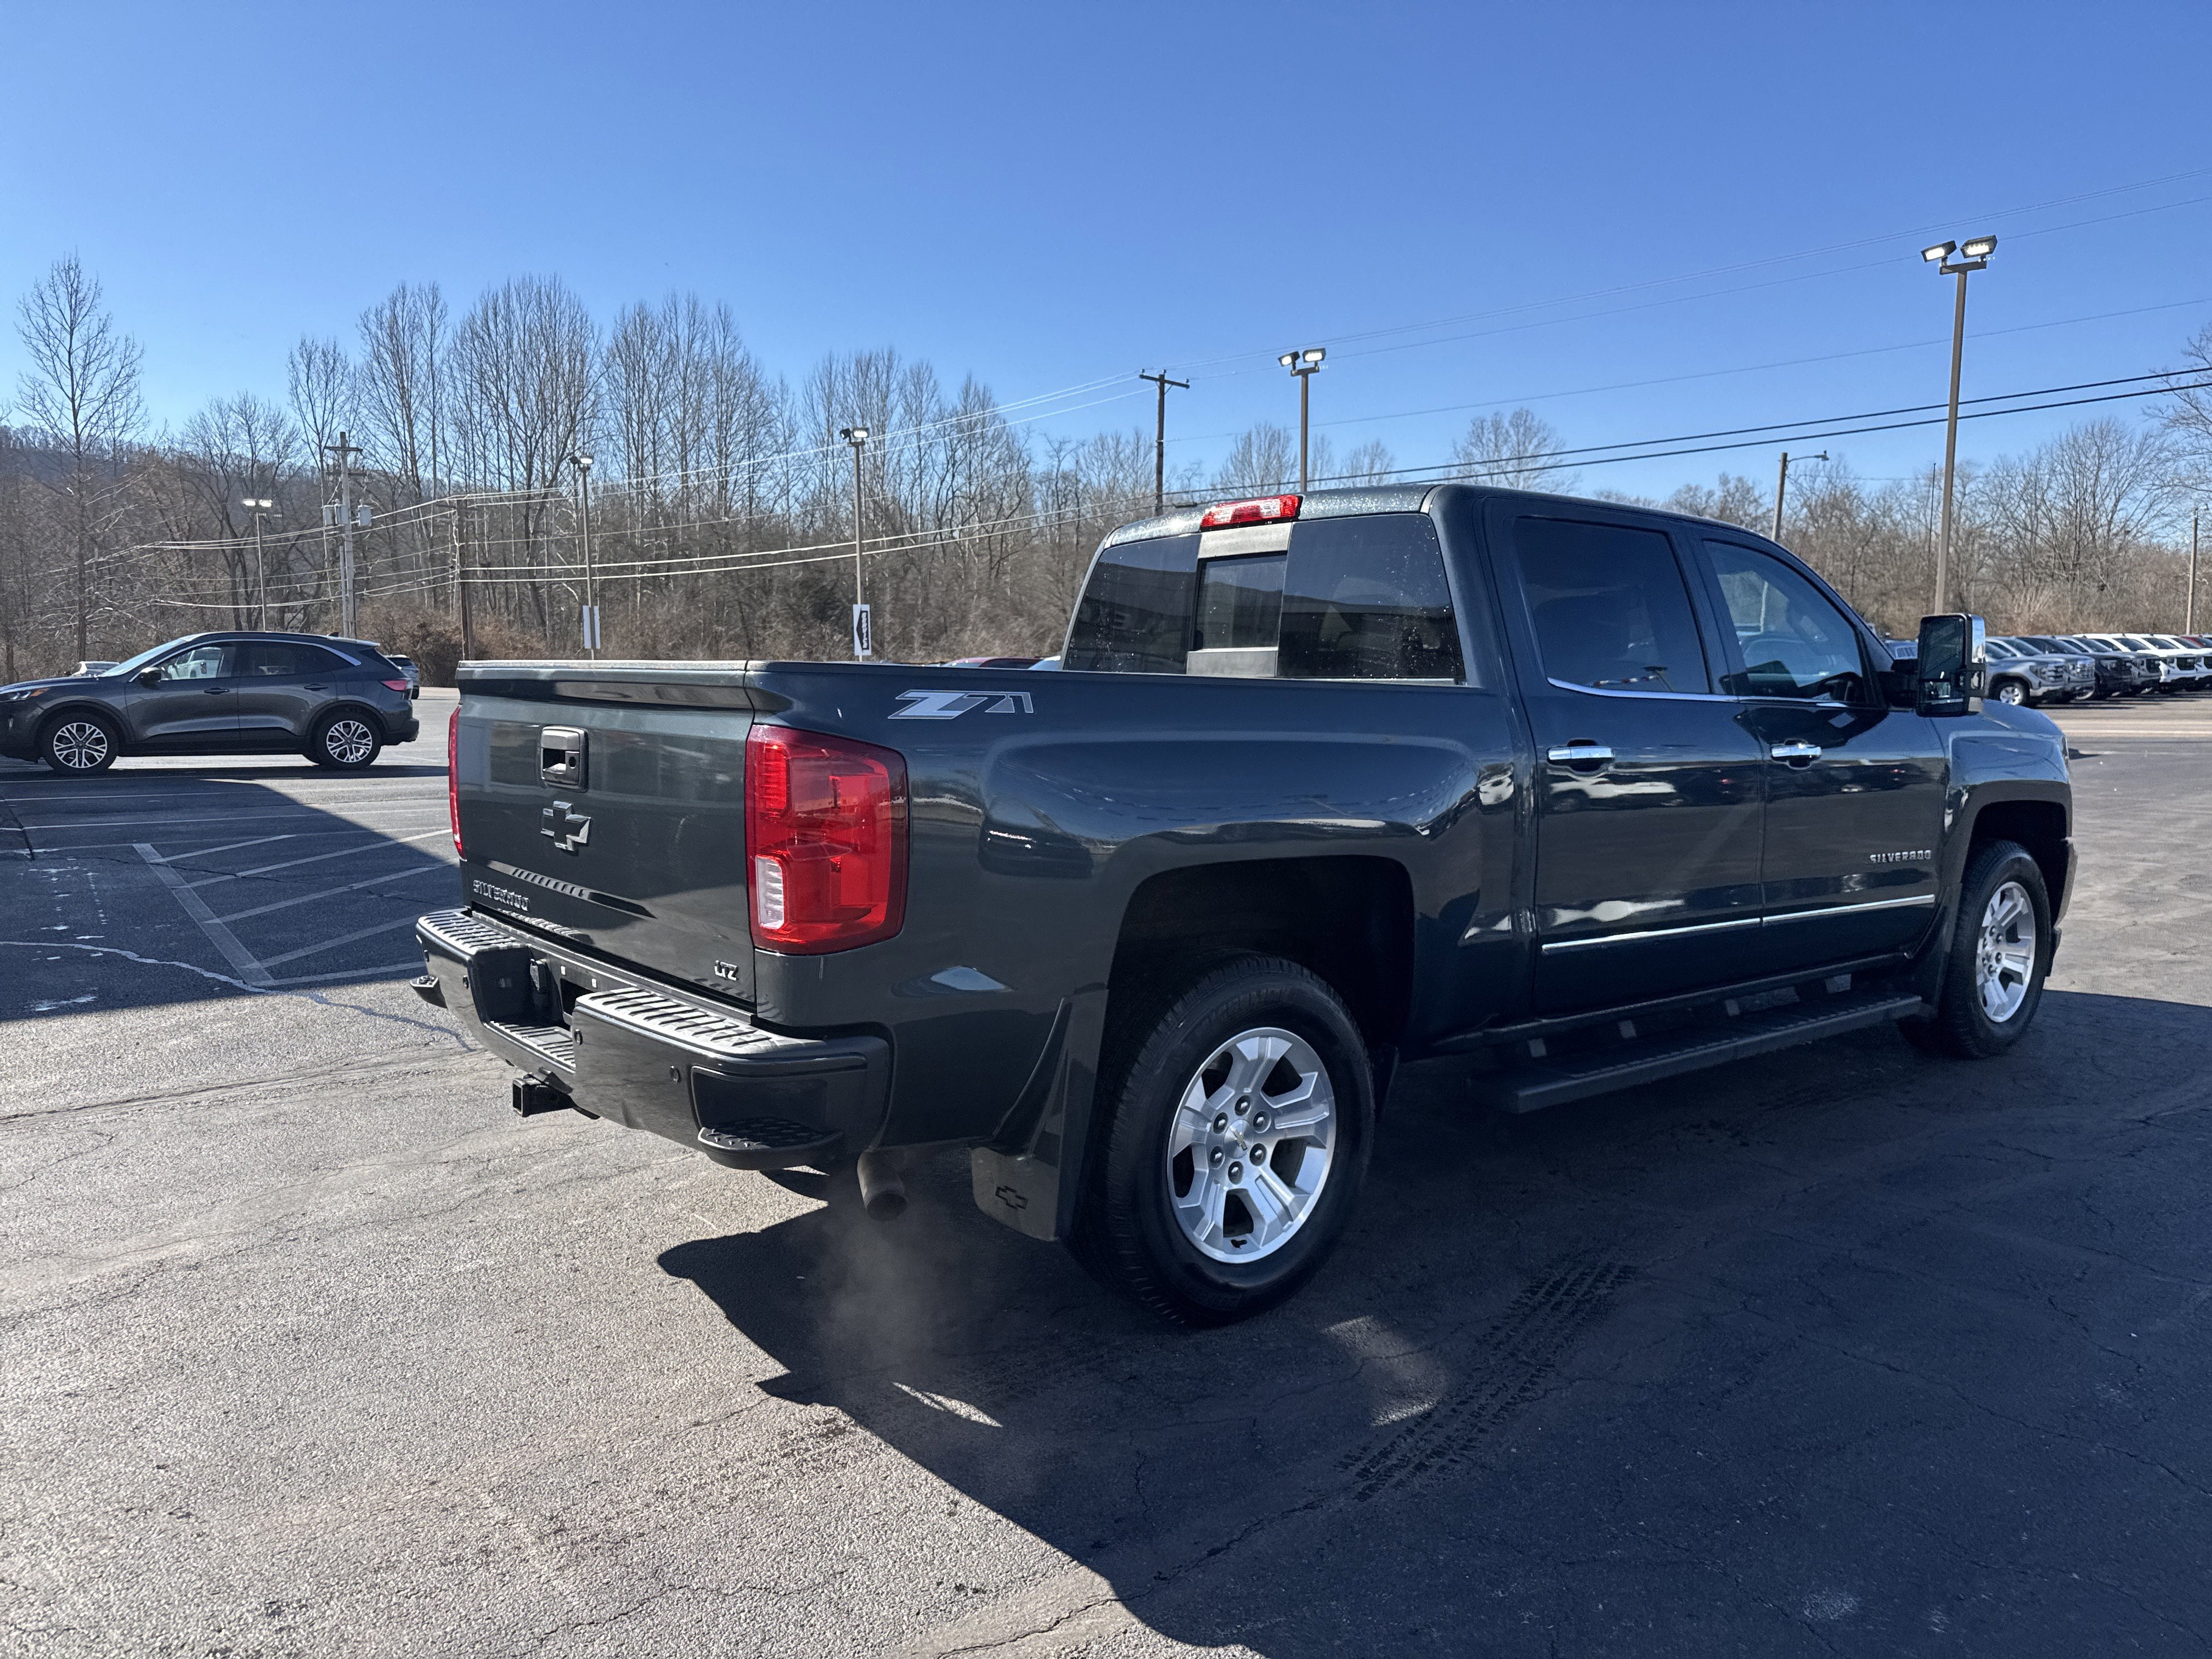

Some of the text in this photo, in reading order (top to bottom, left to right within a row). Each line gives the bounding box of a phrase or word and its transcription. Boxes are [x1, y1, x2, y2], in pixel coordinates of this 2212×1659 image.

[888, 689, 1034, 719] Z71
[1870, 850, 1932, 864] SILVERADO
[473, 880, 530, 911] SILVERADO
[714, 960, 738, 981] LTZ
